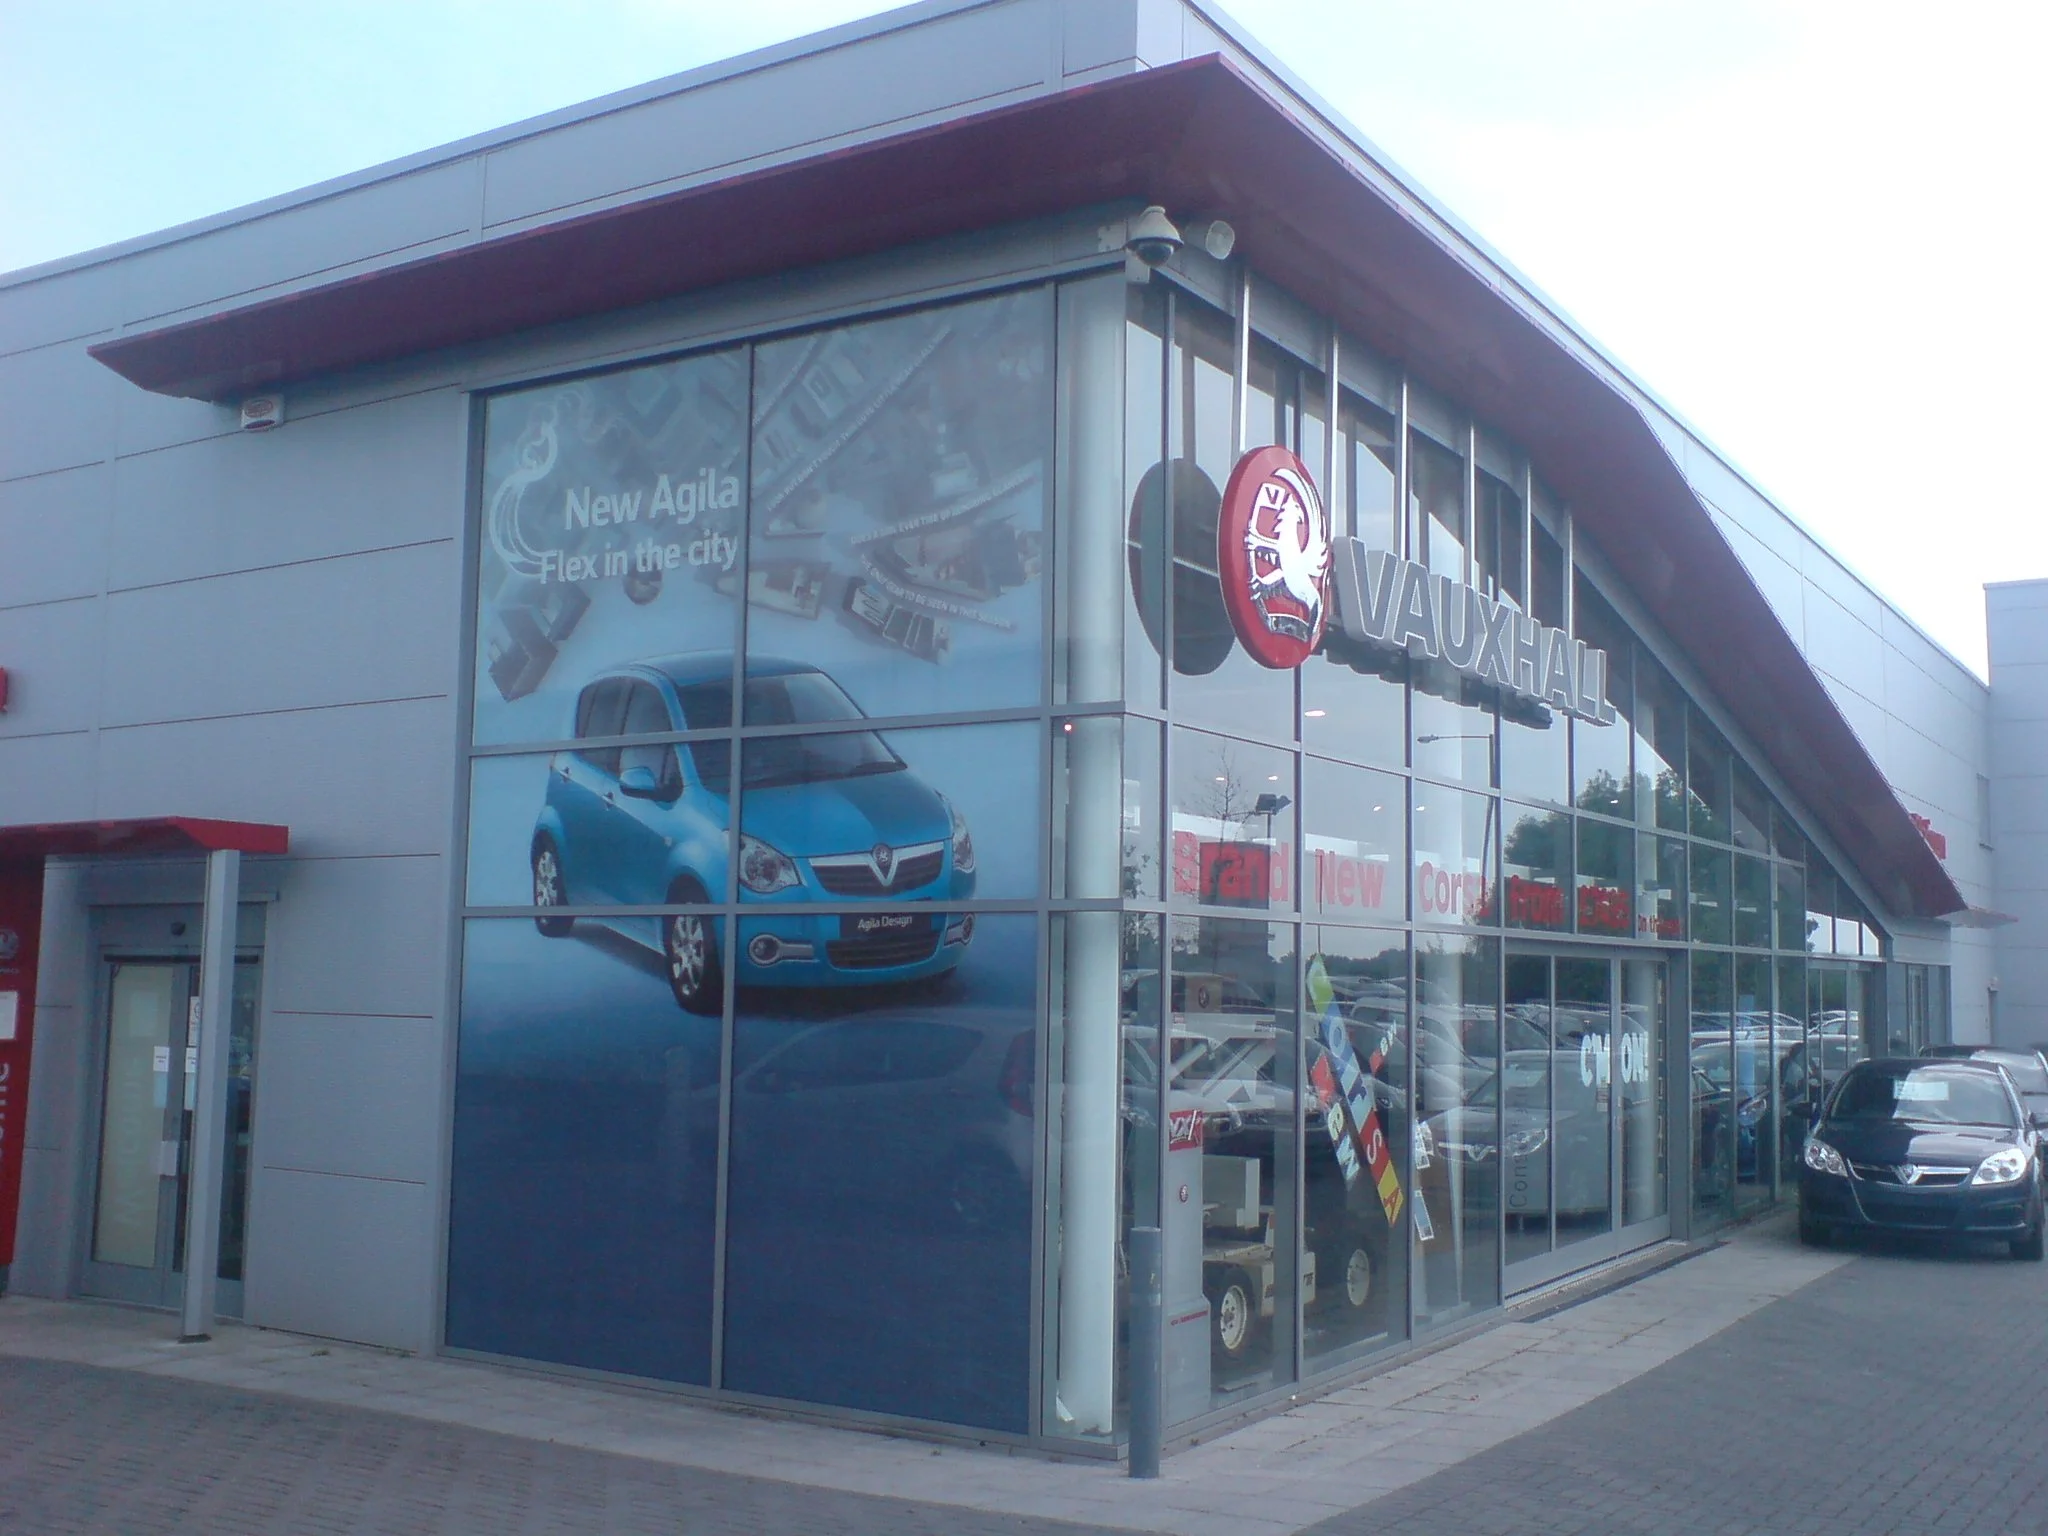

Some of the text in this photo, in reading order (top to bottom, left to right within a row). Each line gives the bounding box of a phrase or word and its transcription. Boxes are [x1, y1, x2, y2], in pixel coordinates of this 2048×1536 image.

[565, 467, 740, 530] New Agila
[540, 528, 738, 585] Flex in the city
[1336, 536, 1614, 725] VAUXHALL
[1174, 830, 1288, 901] Brand
[1315, 848, 1384, 908] New
[1418, 860, 1490, 917] Corsa
[1510, 874, 1566, 926] from
[858, 915, 913, 931] Agila Design
